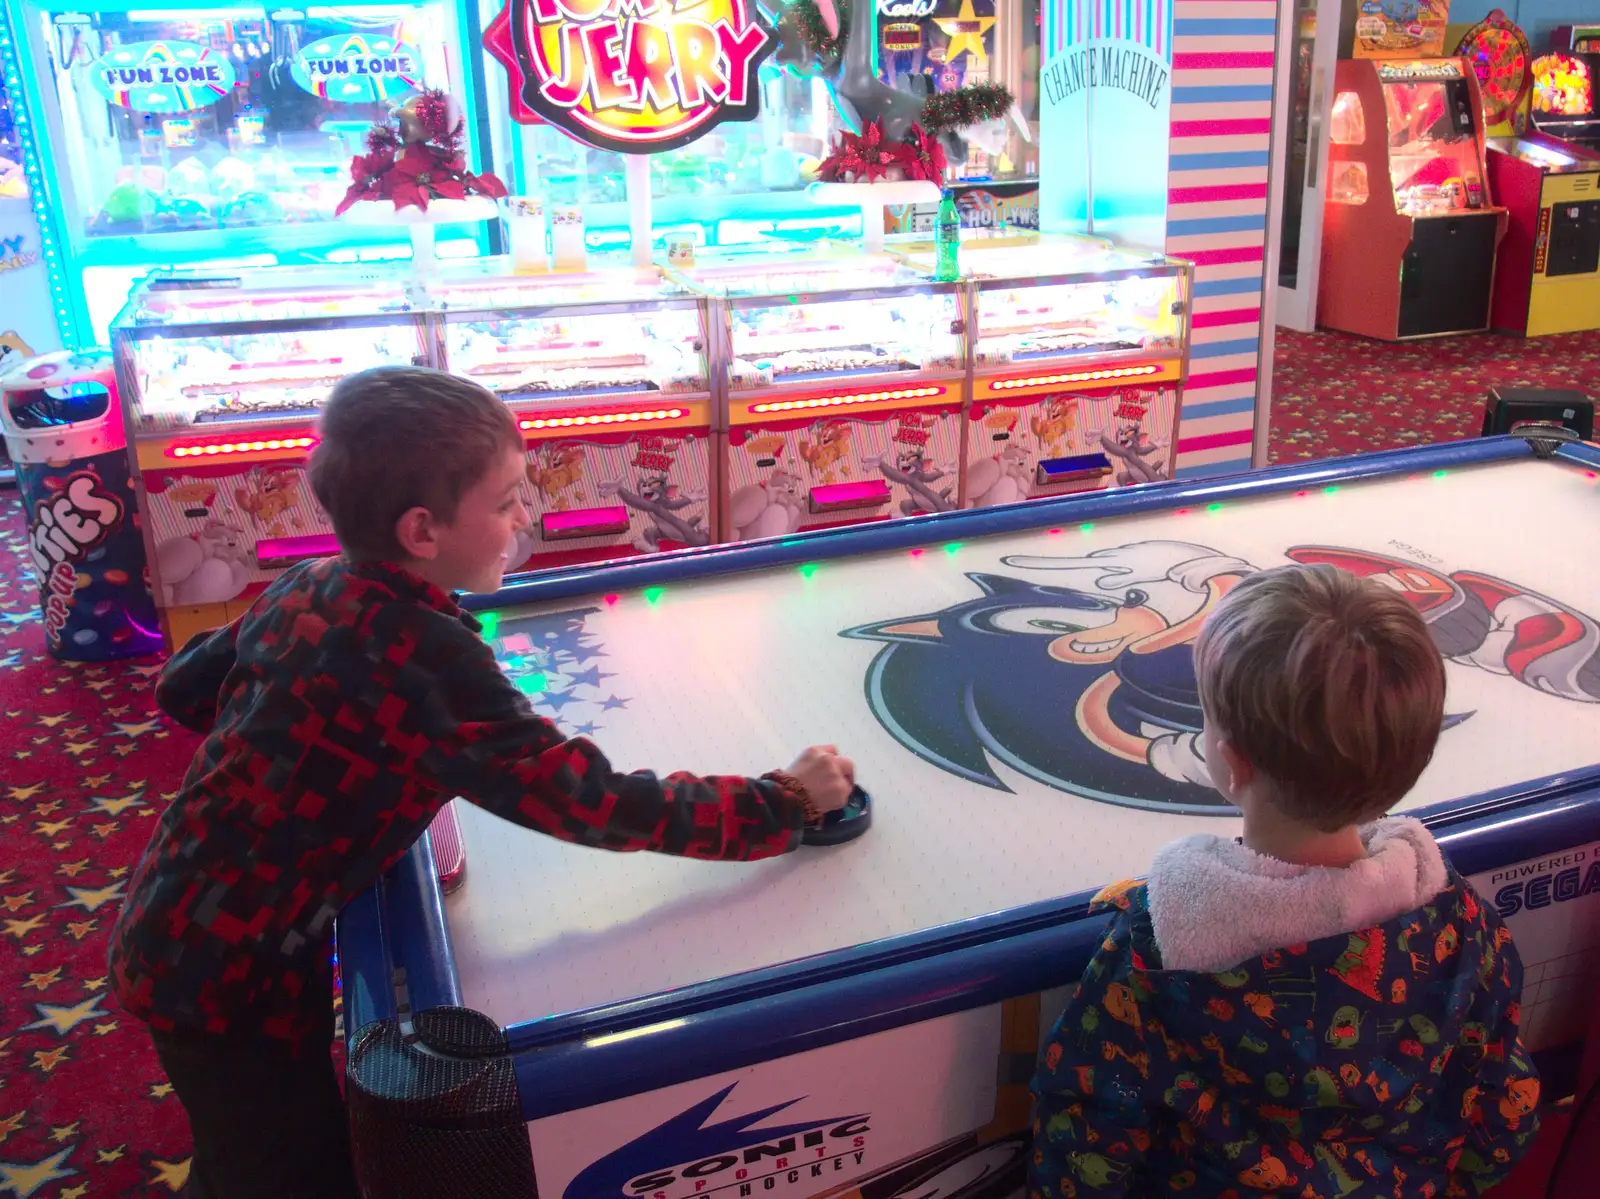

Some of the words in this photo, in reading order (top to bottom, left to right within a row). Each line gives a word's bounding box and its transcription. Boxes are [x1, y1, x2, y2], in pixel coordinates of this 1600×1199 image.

[106, 67, 153, 85] FUN
[159, 65, 220, 84] ZONE
[306, 59, 349, 75] FUN
[355, 57, 412, 75] ZONE
[539, 17, 770, 110] JERRY
[1100, 46, 1168, 110] MACHINE
[1113, 402, 1148, 422] JERRY
[891, 427, 932, 447] JERRY
[630, 451, 676, 473] JERRY
[50, 562, 79, 598] UP
[45, 595, 70, 643] POP
[1492, 851, 1586, 885] POWERED
[1494, 861, 1600, 918] SEGA
[631, 1115, 872, 1195] SONIC
[653, 1136, 865, 1199] SPORTS
[739, 1151, 865, 1197] HOCKEY
